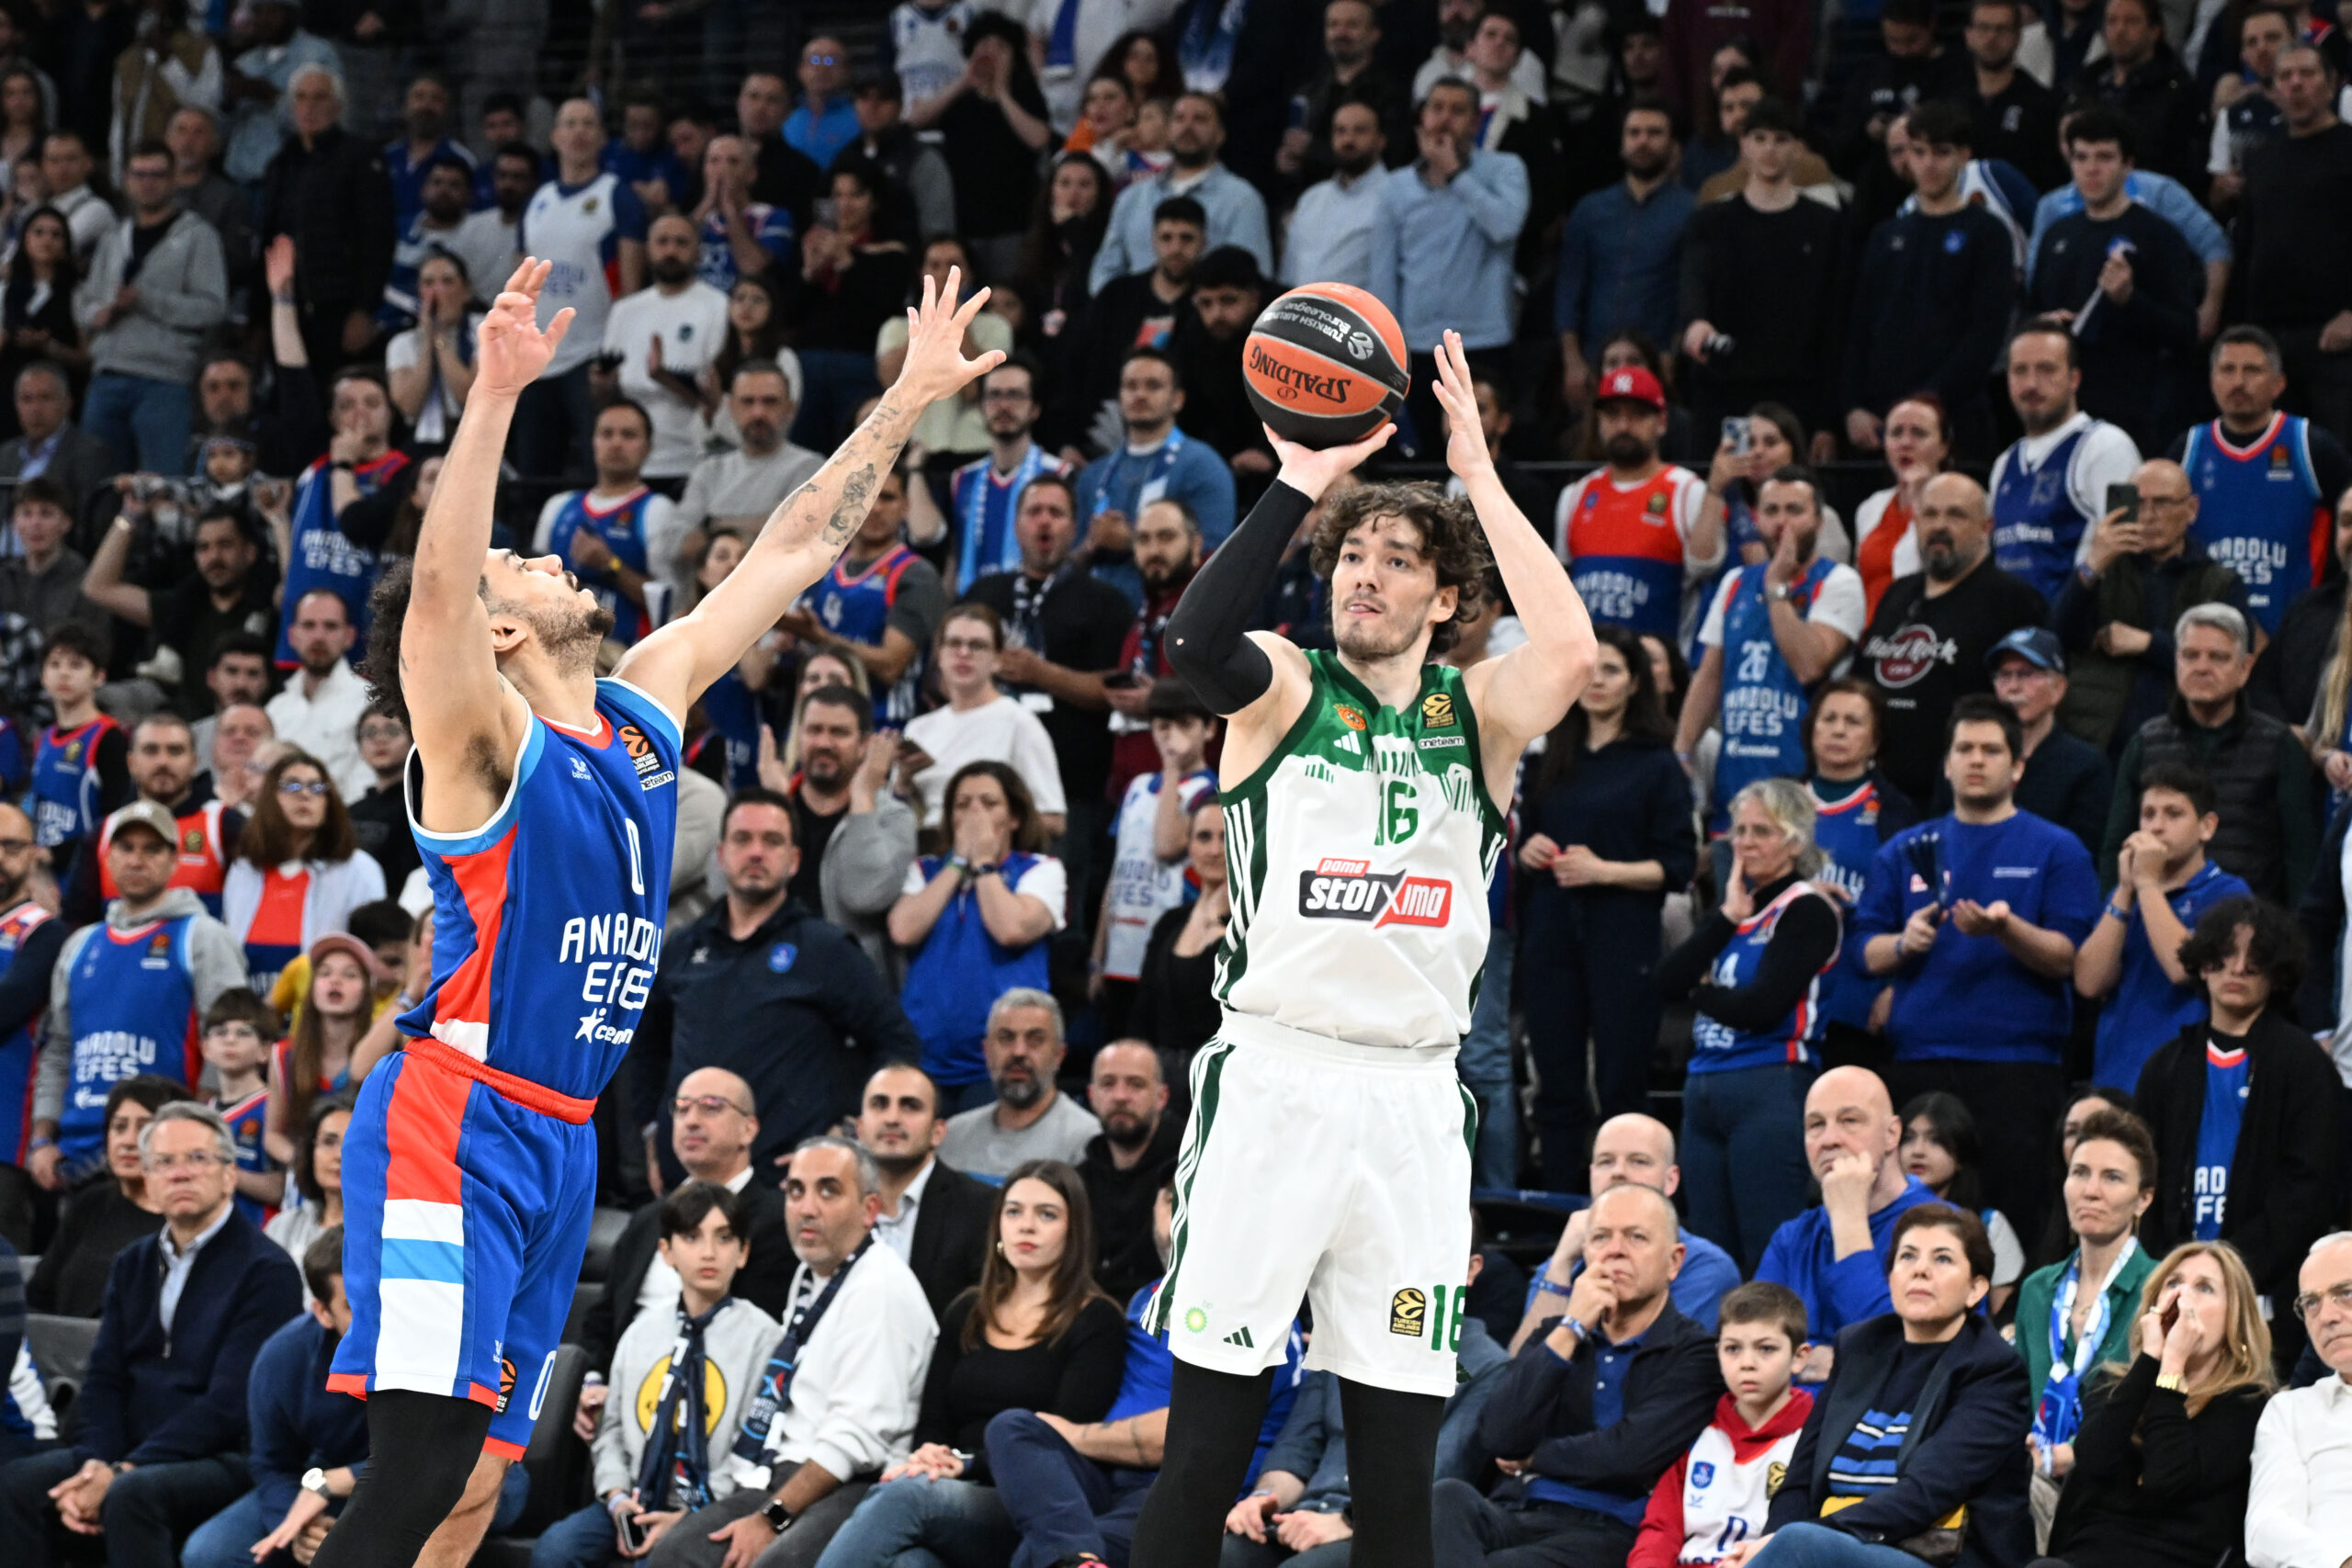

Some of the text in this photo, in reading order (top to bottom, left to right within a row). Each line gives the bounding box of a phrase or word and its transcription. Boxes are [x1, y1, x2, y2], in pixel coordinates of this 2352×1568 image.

[1299, 316, 1344, 344] TURKISH
[1250, 344, 1351, 403] SPALDING
[1419, 737, 1464, 748] oneteam
[1374, 780, 1419, 846] 16
[625, 818, 645, 896] 0
[1319, 860, 1366, 874] pame
